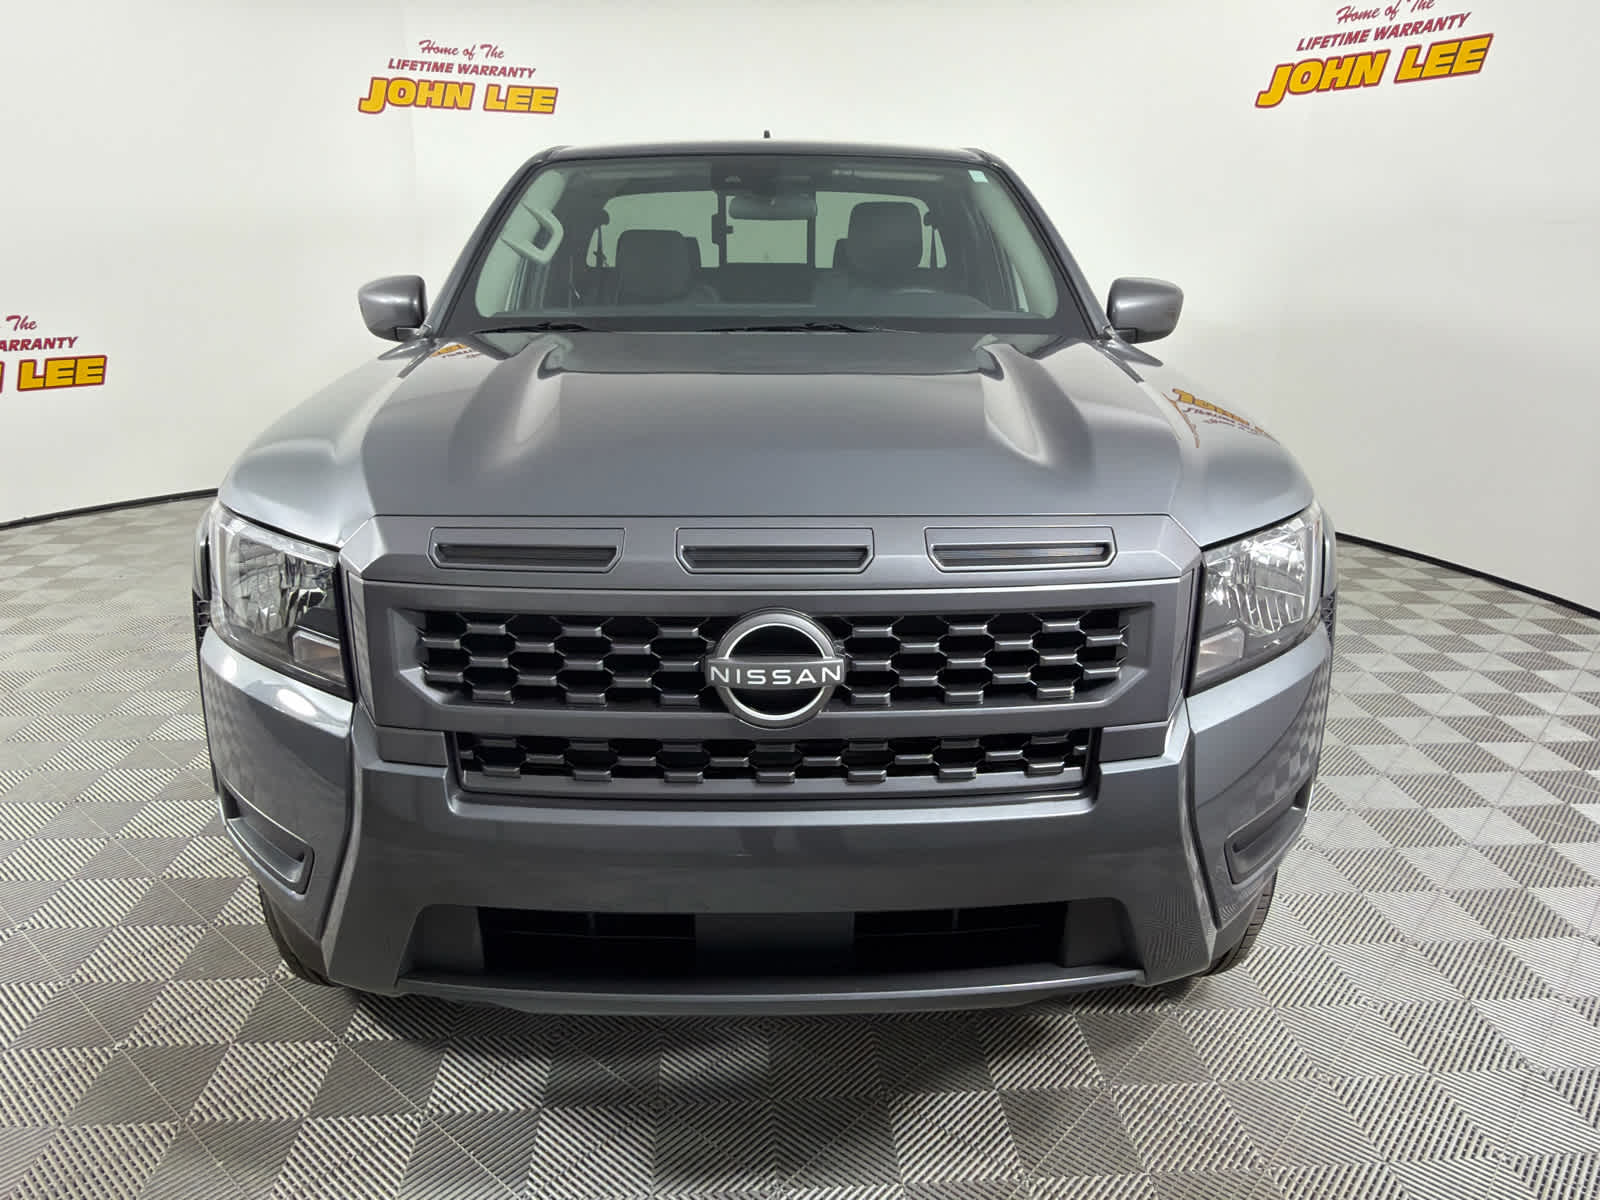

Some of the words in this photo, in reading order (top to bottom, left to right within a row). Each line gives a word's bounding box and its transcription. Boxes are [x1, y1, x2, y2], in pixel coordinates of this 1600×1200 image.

[1336, 6, 1381, 24] Home
[1384, 0, 1402, 21] of
[1296, 28, 1371, 51] LIFETIME
[1373, 12, 1472, 41] WARRANTY
[418, 39, 460, 56] Home
[462, 44, 476, 60] of
[479, 44, 504, 59] The
[387, 58, 454, 74] LIFETIME
[457, 63, 536, 78] WARRANTY
[1255, 49, 1391, 108] JOHN
[1393, 33, 1494, 83] LEE
[358, 76, 475, 114] JOHN
[483, 83, 558, 114] LEE
[5, 314, 39, 331] The
[0, 336, 79, 352] ARRANTY
[16, 354, 107, 392] LEE
[710, 665, 841, 686] NISSAN
